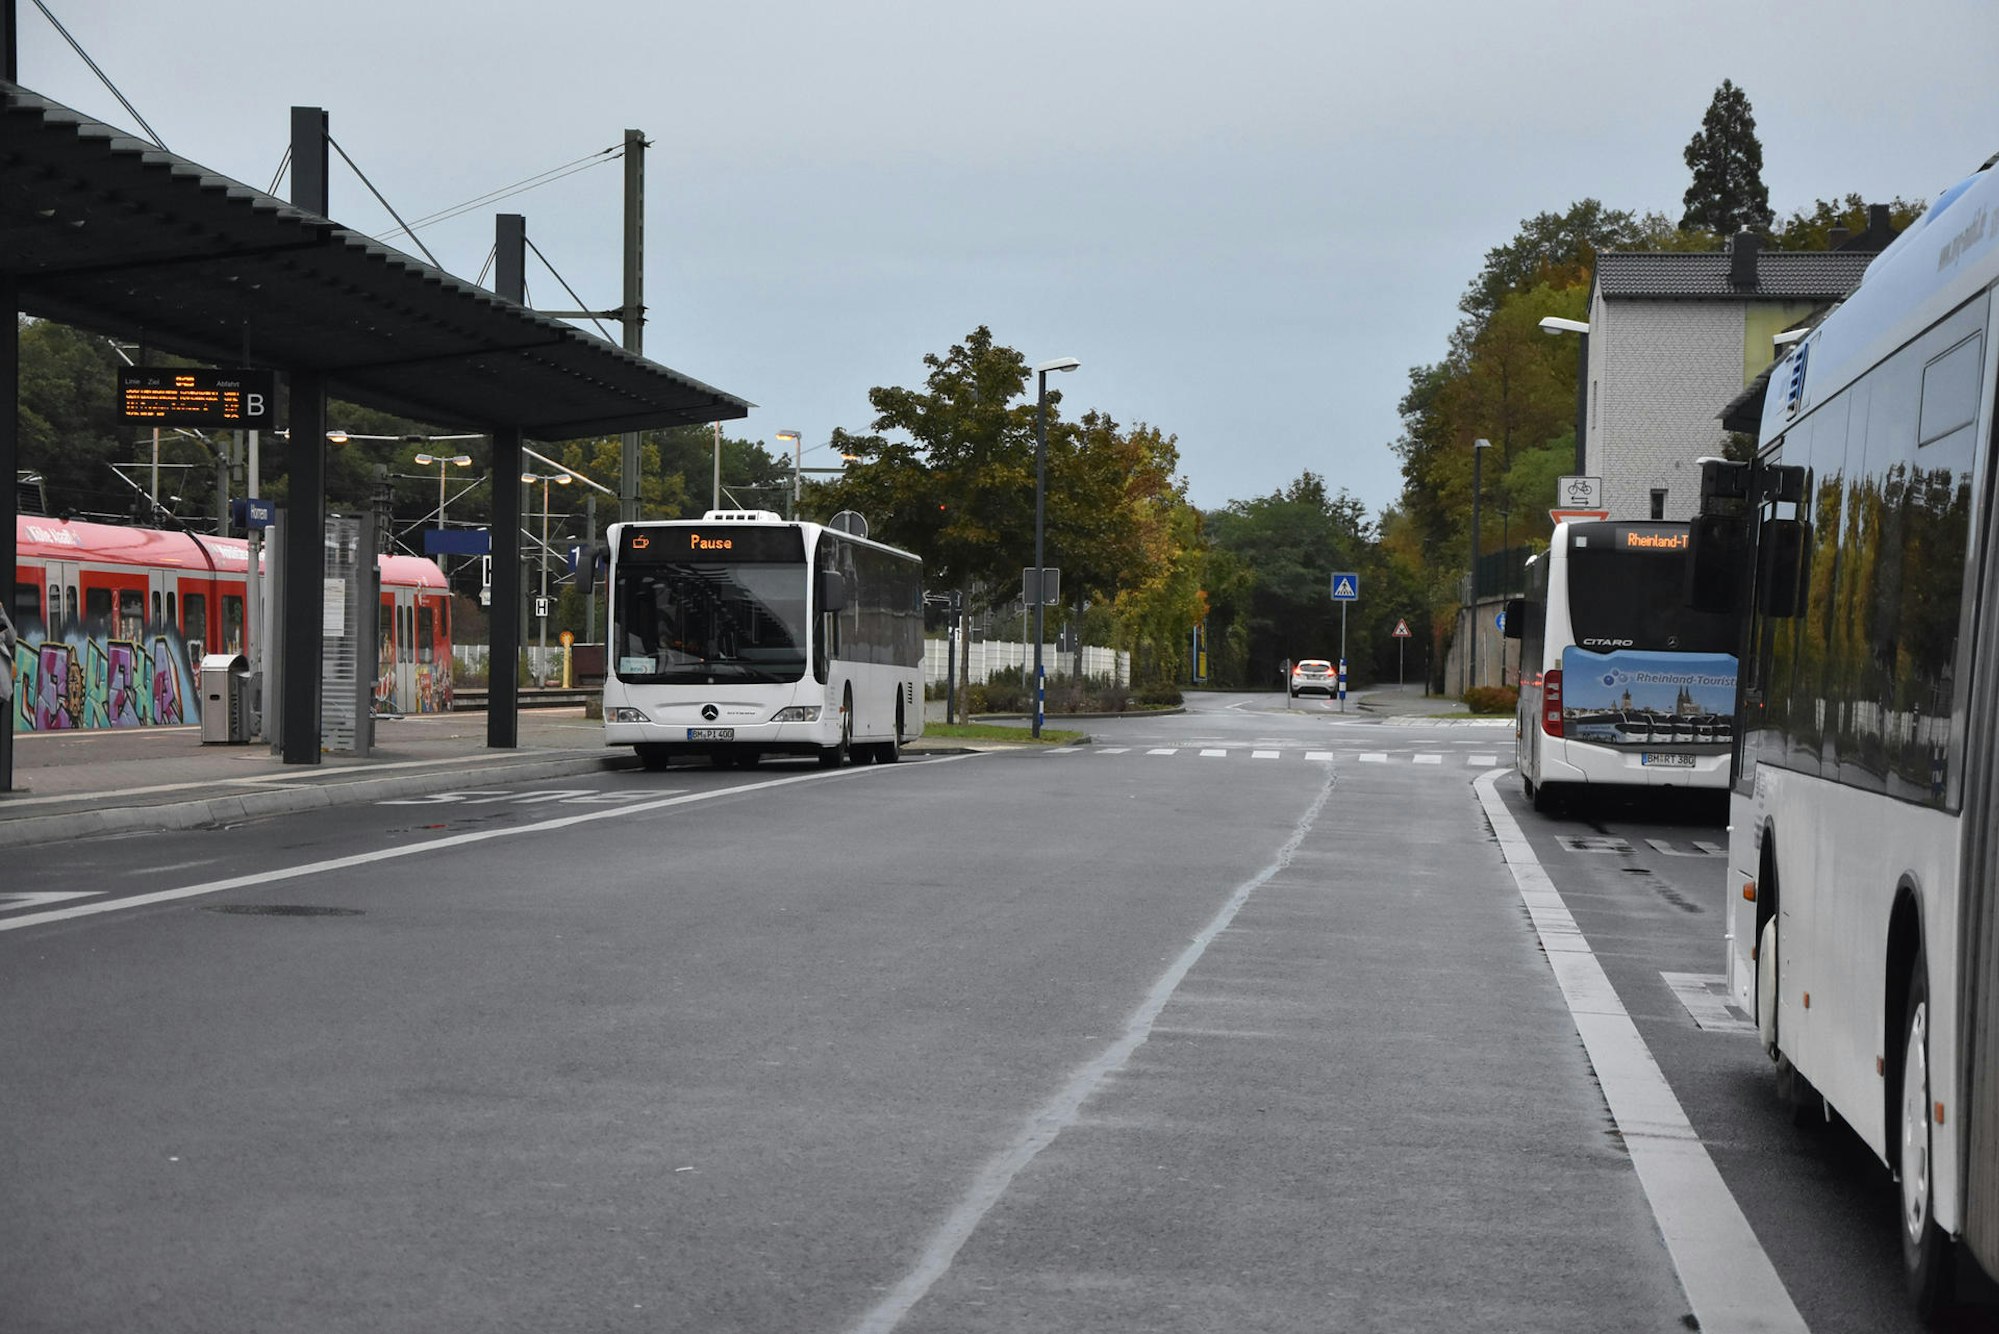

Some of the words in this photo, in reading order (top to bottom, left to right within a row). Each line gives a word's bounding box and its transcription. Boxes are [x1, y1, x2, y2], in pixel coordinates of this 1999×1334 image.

[247, 394, 265, 416] B
[250, 504, 268, 519] Horrem
[690, 534, 733, 549] Pause
[1628, 532, 1689, 548] Rheinland-T
[537, 600, 546, 614] H
[1583, 638, 1633, 647] CITARO
[692, 730, 702, 738] BM
[1647, 754, 1660, 763] BM
[1664, 754, 1676, 764] RT
